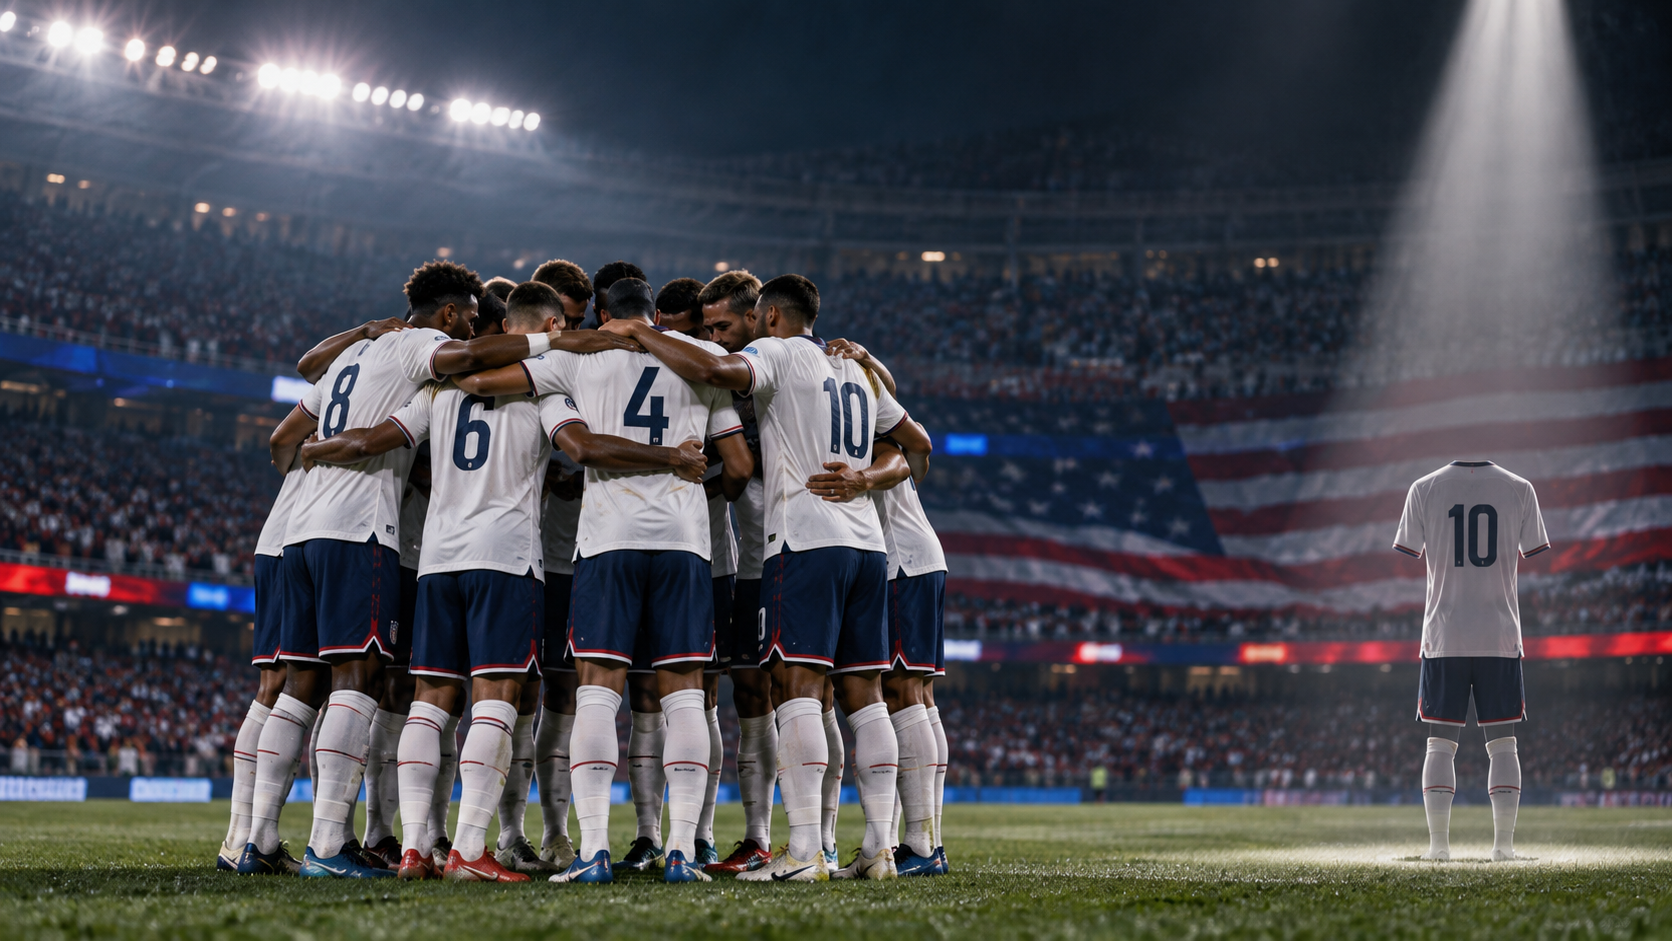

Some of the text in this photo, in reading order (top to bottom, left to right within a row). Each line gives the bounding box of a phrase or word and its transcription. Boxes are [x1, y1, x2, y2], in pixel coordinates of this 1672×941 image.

[323, 363, 360, 439] 8
[453, 393, 495, 471] 6
[623, 366, 669, 445] 4
[823, 377, 869, 459] 10
[1448, 504, 1498, 567] 10
